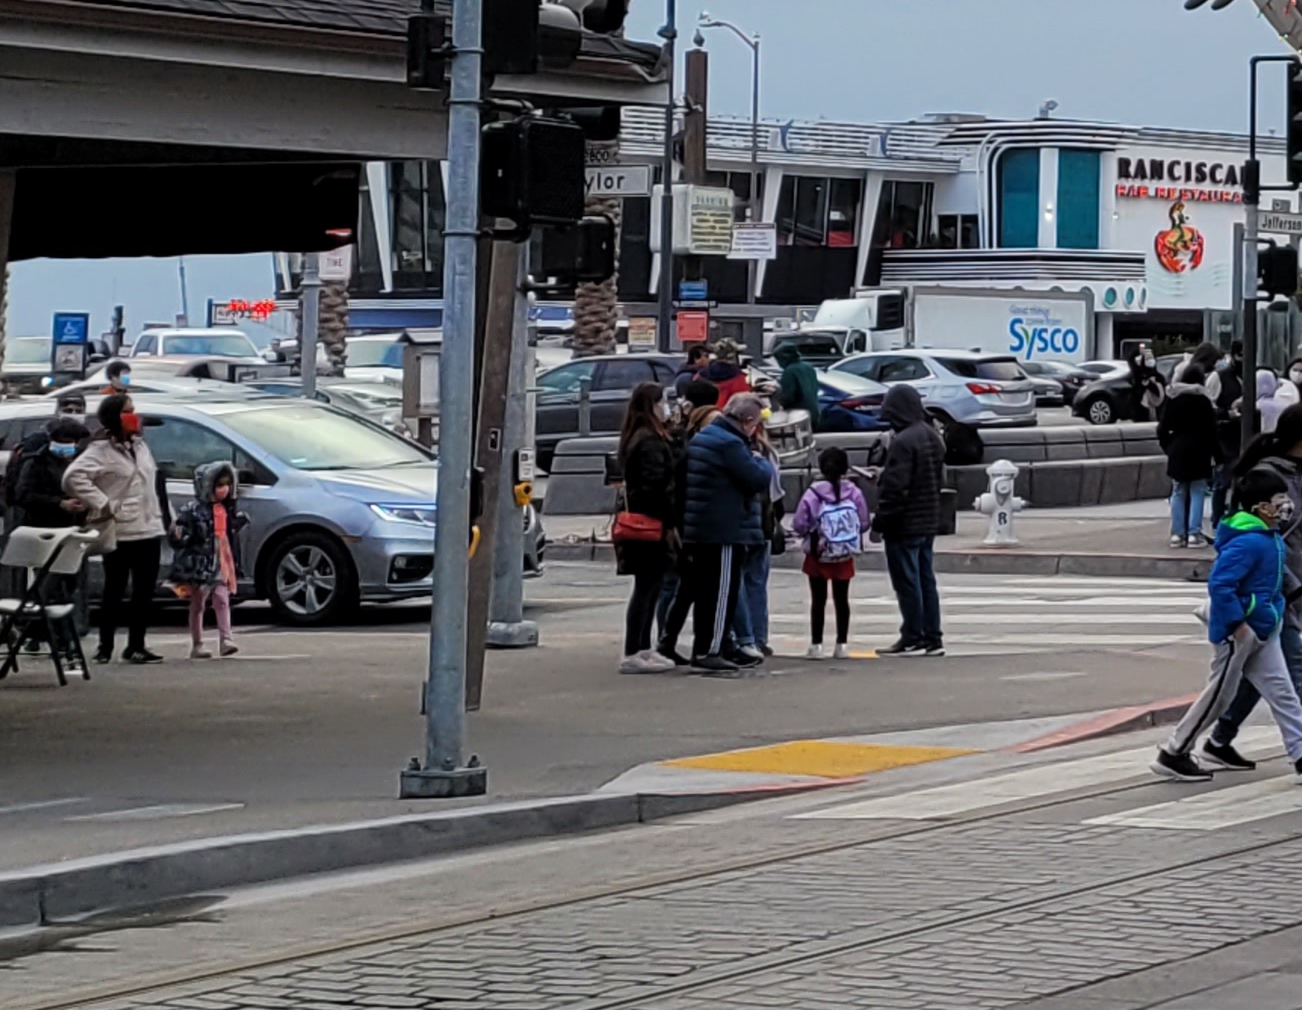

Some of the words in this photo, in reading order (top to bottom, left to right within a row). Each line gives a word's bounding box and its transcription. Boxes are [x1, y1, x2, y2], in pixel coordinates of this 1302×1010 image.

[1117, 156, 1245, 187] RANCISCA
[585, 172, 625, 193] ylor
[1155, 185, 1244, 204] RESTAURA
[1261, 214, 1302, 230] Jefferson
[1009, 317, 1079, 360] Sysco
